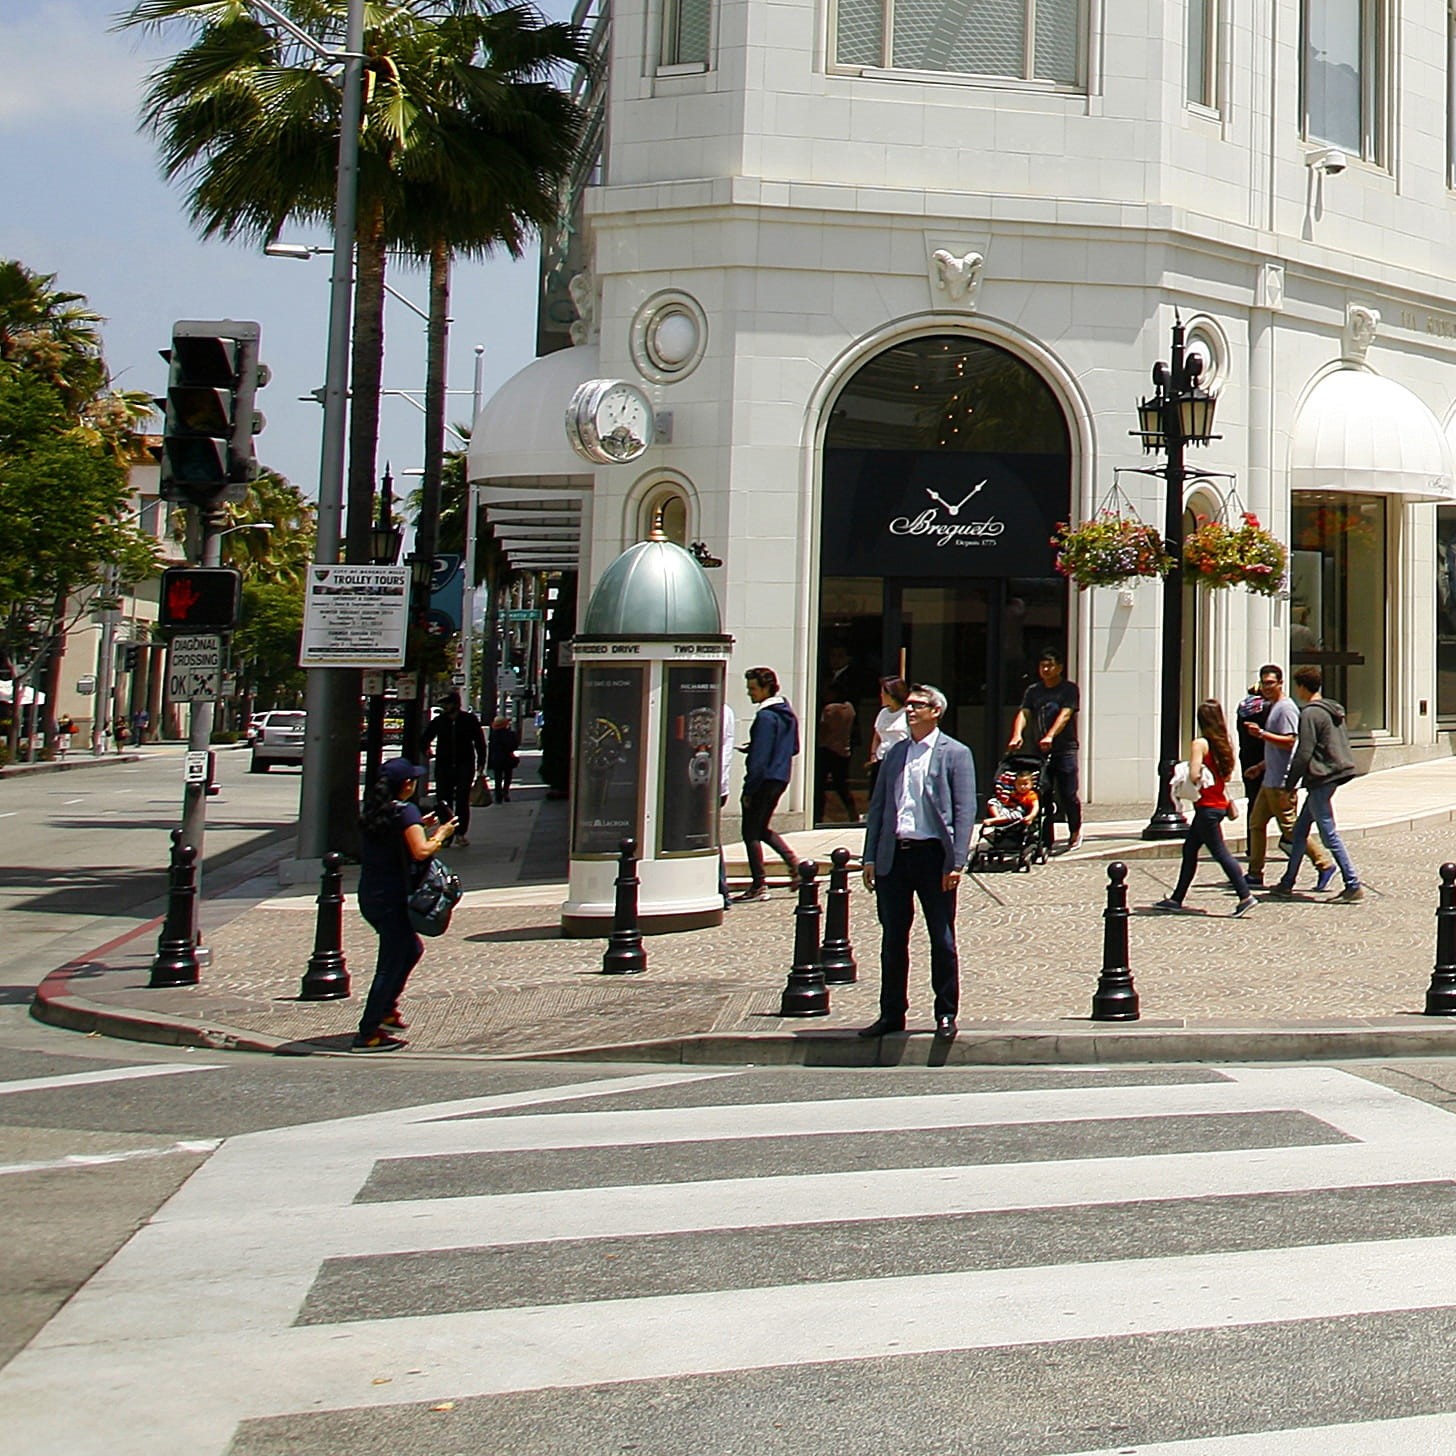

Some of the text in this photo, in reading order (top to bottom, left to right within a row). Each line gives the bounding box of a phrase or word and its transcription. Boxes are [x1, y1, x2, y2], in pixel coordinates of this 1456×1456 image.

[889, 508, 1005, 546] Breguet
[334, 575, 405, 585] TROLLEY TOURS
[174, 639, 217, 651] DIAGONAL
[612, 645, 640, 653] DRIVE
[674, 645, 694, 653] TWO
[173, 654, 218, 666] CROSSING
[170, 675, 187, 695] OK
